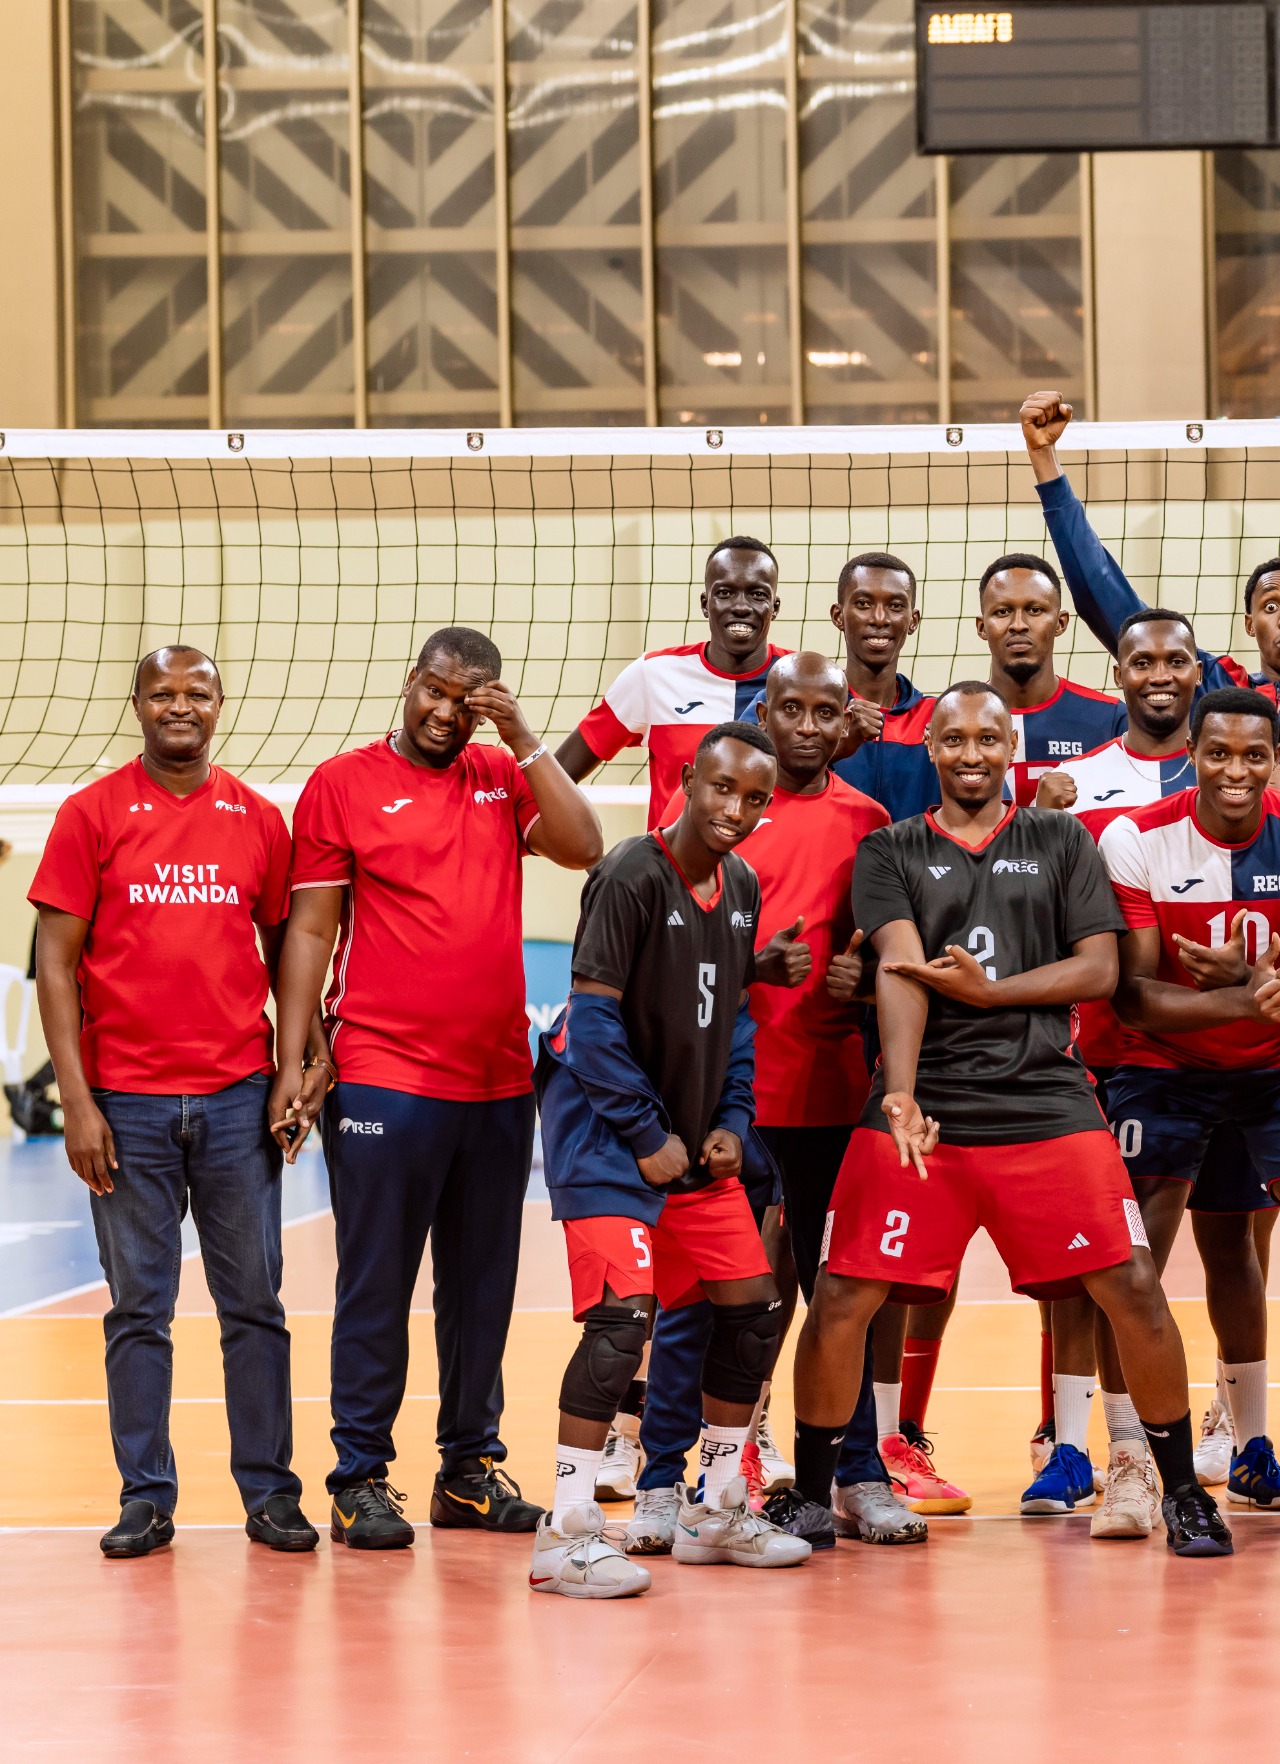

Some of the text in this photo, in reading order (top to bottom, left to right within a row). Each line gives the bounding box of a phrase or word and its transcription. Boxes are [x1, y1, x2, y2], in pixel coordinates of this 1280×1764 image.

[1047, 740, 1083, 755] REG
[224, 803, 247, 815] REG
[153, 862, 219, 884] VISIT
[1007, 861, 1039, 875] REG
[128, 883, 240, 905] RWANDA
[1206, 910, 1271, 964] 10
[697, 962, 717, 1028] 5
[353, 1121, 384, 1135] REG
[880, 1209, 910, 1258] 2
[630, 1227, 651, 1268] 5
